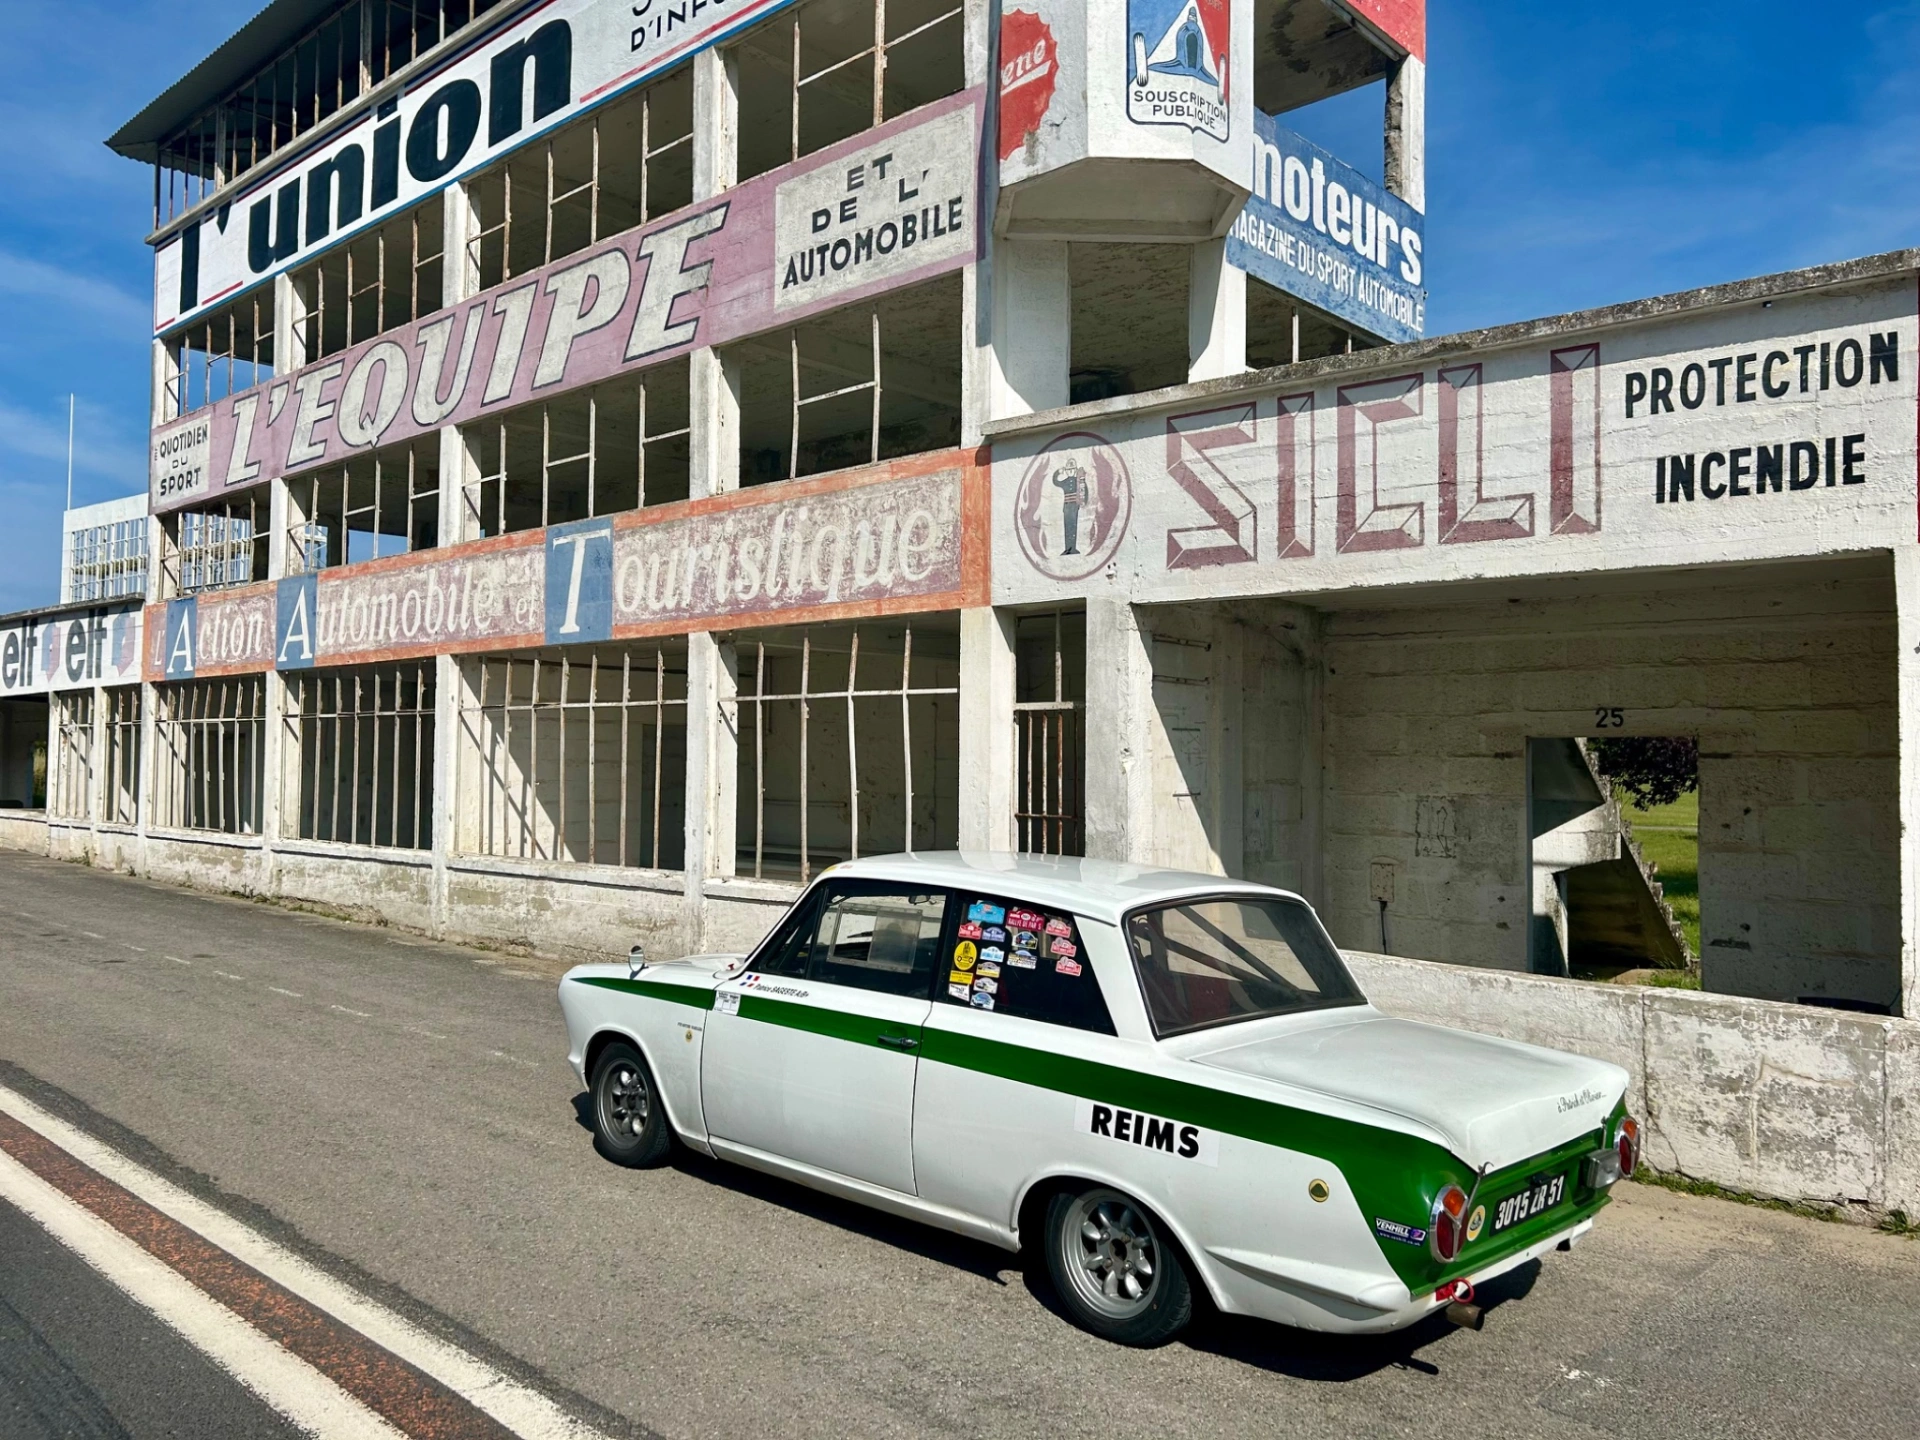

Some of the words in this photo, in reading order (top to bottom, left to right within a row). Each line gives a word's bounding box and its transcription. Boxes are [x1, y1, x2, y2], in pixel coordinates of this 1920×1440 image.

[631, 0, 726, 53] D'INF
[1134, 90, 1226, 122] SOUSCRIPTION
[1153, 104, 1215, 130] PUBLIQUE
[179, 18, 572, 314] l'union
[847, 153, 893, 192] ET
[811, 197, 858, 234] DE
[898, 168, 930, 204] L'
[782, 195, 964, 290] AUTOMOBILE
[1298, 238, 1316, 277] DU
[1317, 251, 1356, 298] SPORT
[1357, 273, 1424, 333] AUTOMOBILE
[224, 200, 731, 487] L'EQUIPE
[1625, 331, 1899, 418] PROTECTION
[159, 423, 208, 459] QUOTIDIEN
[172, 456, 188, 469] DU
[1166, 343, 1601, 569] SICLI
[1655, 433, 1866, 503] INCENDIE
[160, 467, 202, 497] SPORT
[277, 562, 494, 662] Automobile
[2, 617, 38, 689] elf
[66, 606, 108, 682] elf
[1595, 707, 1624, 728] 25
[1090, 1104, 1199, 1158] REIMS
[1376, 1219, 1410, 1237] VENHILL
[1495, 1191, 1531, 1230] 3015
[1530, 1184, 1548, 1214] ZR
[1547, 1175, 1565, 1206] 51
